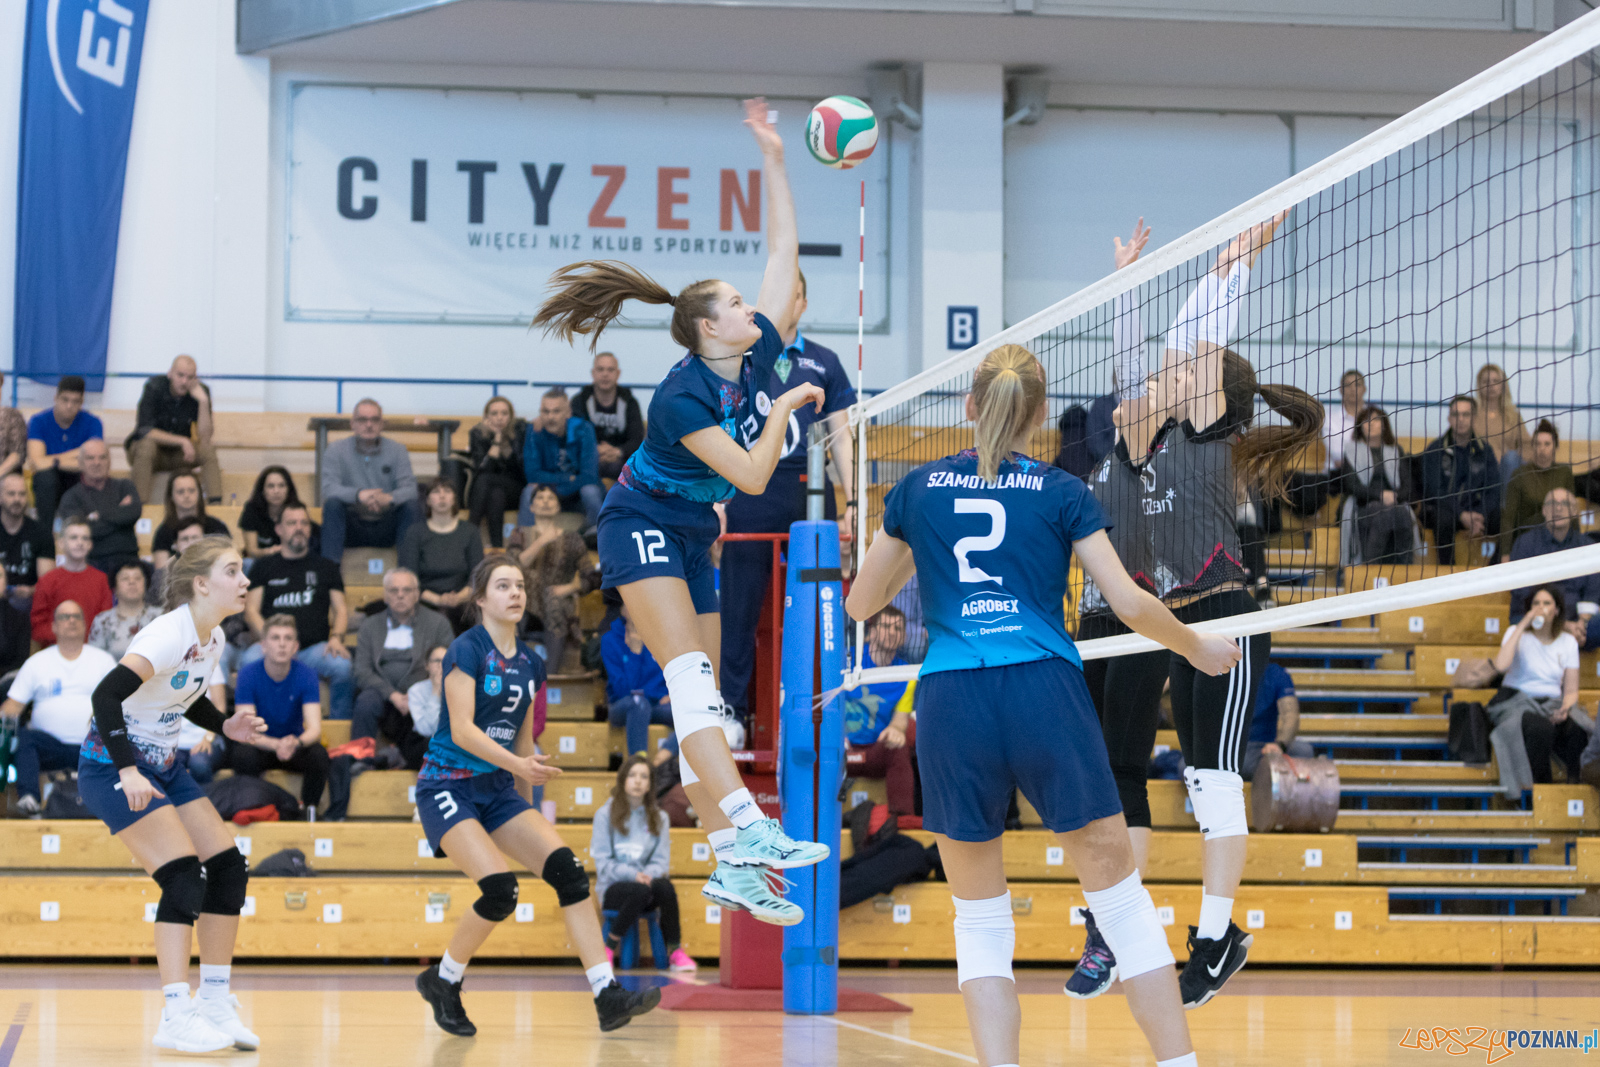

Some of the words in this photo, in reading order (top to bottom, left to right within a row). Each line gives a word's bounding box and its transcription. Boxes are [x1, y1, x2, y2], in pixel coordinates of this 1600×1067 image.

[336, 156, 762, 232] CITYZEN
[592, 236, 643, 251] KLUB
[654, 237, 761, 254] SPORTOWY
[953, 312, 973, 343] B
[631, 529, 670, 564] 12
[953, 498, 1007, 586] 2
[961, 599, 1020, 617] AGROBEX
[980, 625, 1023, 635] Deweloper
[501, 684, 523, 713] 3
[434, 790, 459, 820] 3
